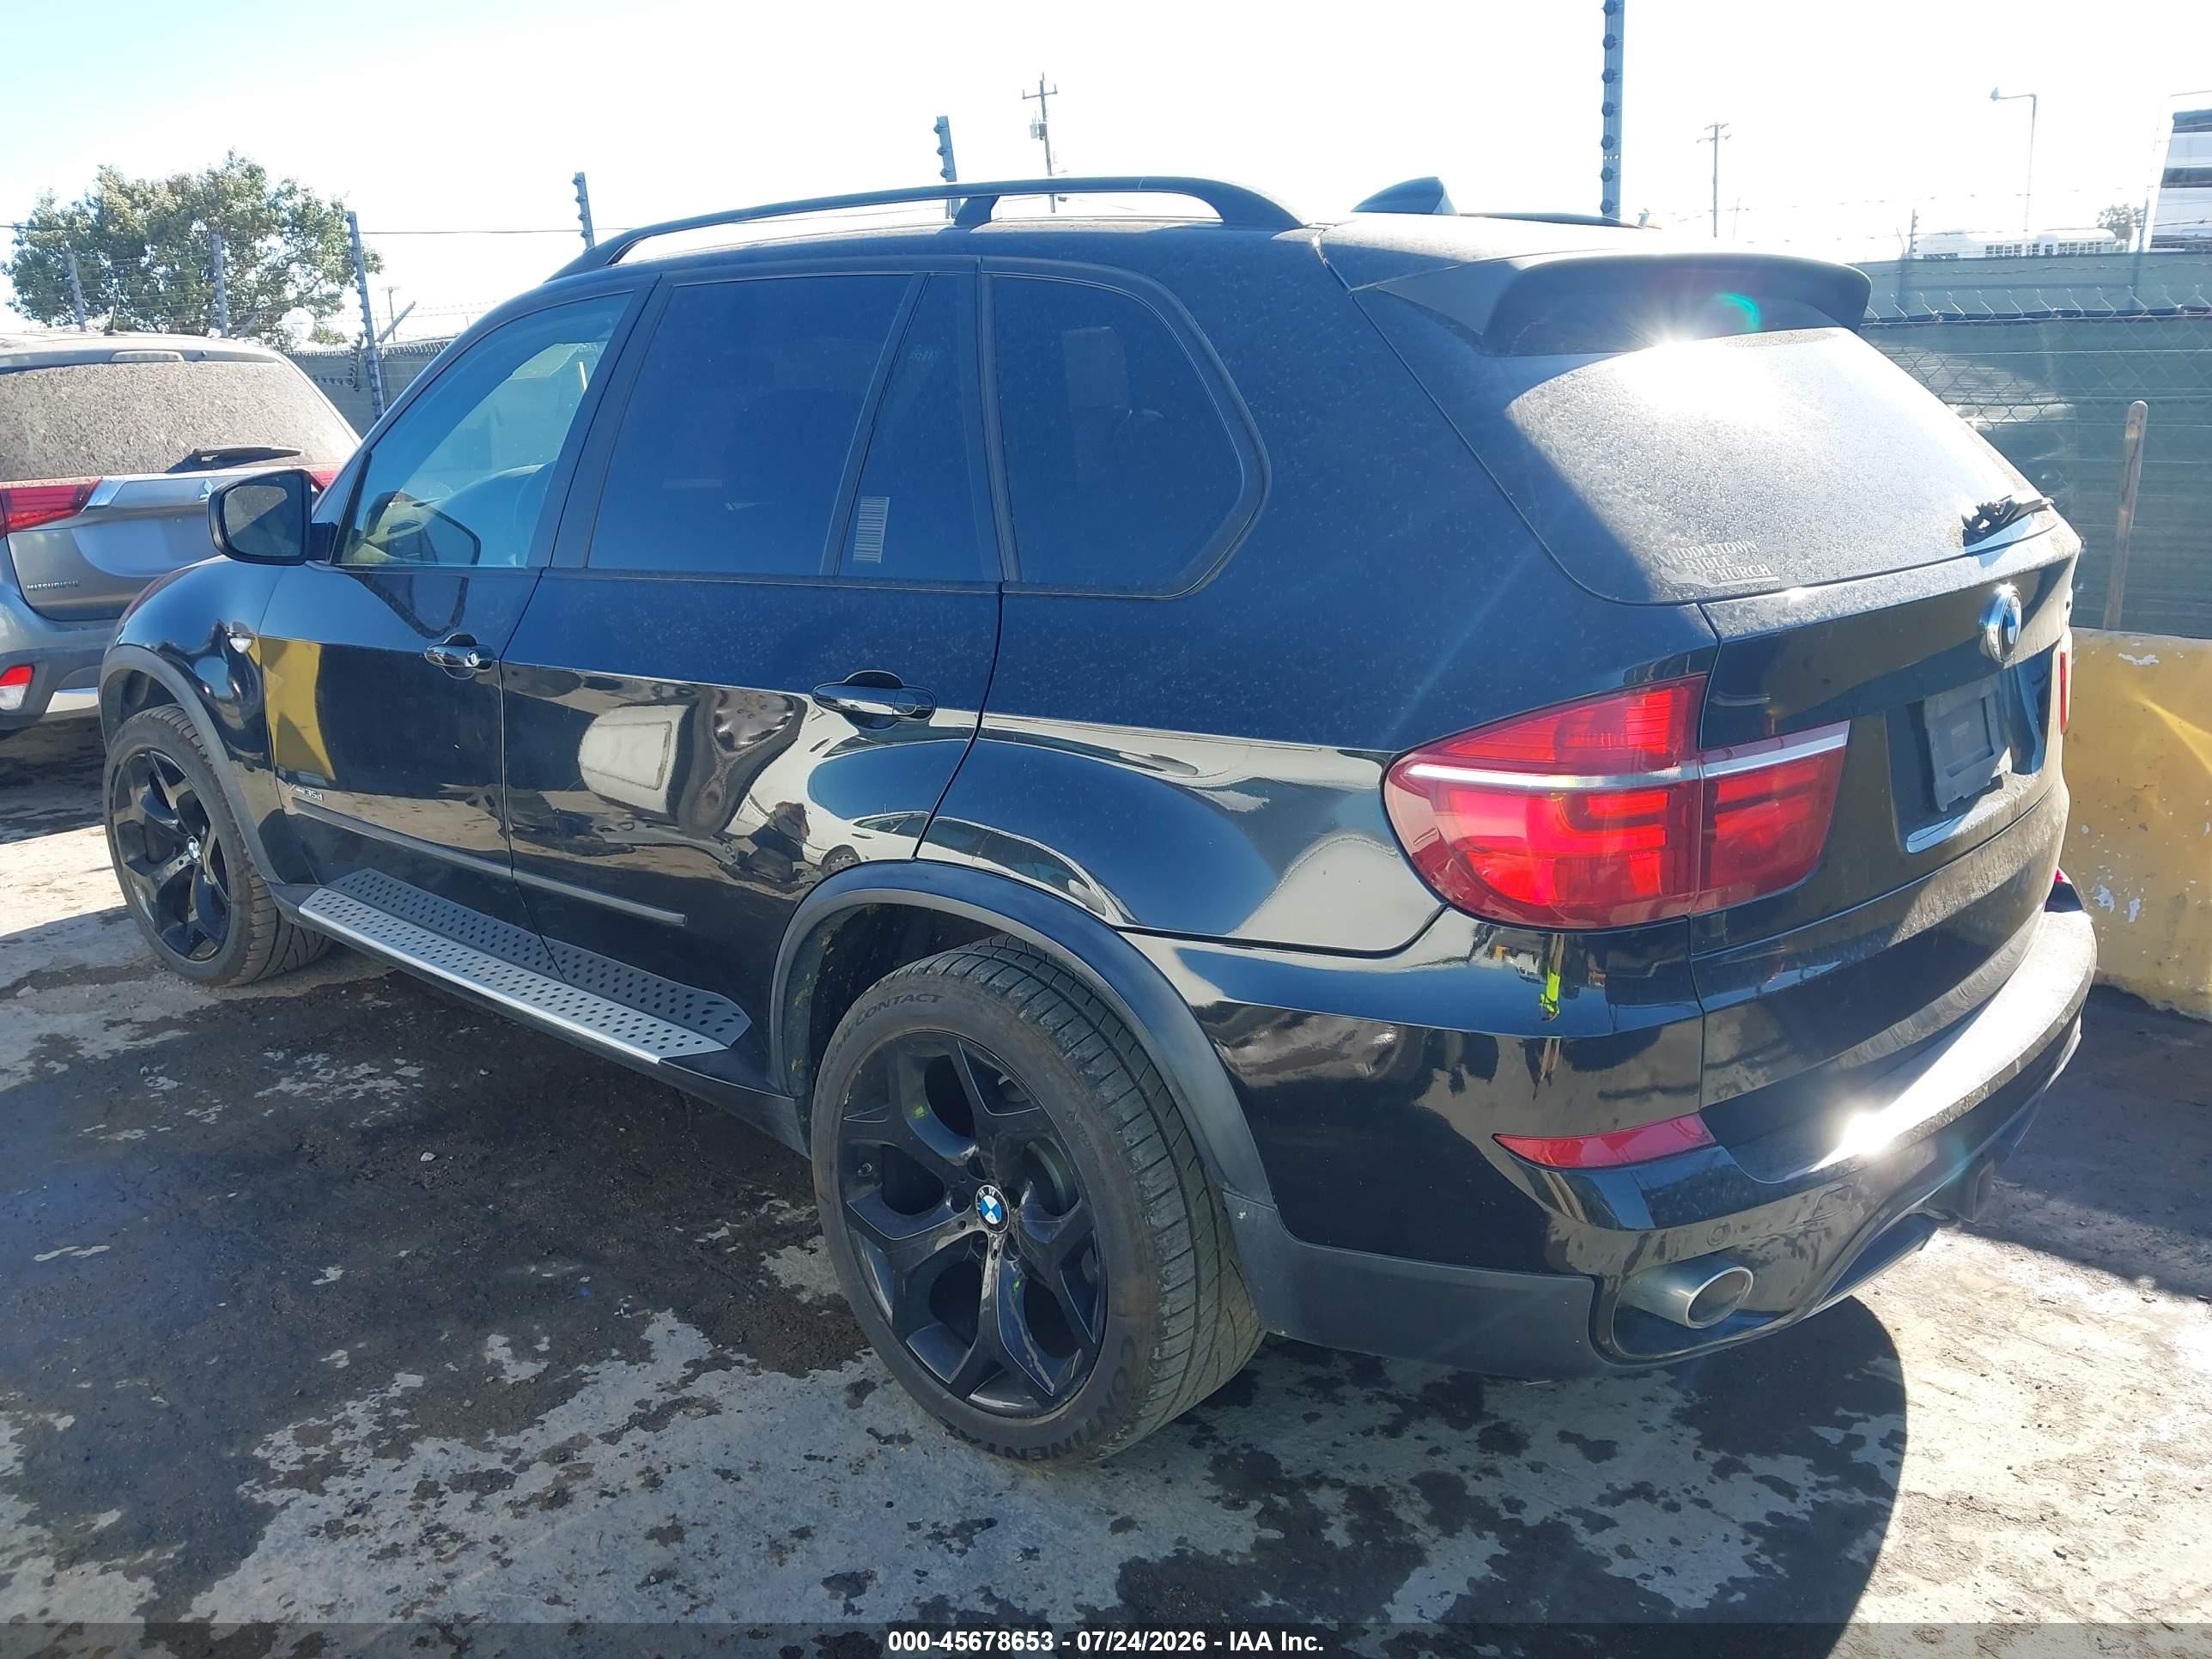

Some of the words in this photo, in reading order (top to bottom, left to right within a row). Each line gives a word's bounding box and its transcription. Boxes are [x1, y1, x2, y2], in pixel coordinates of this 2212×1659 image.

[1651, 540, 1760, 568] MIDDLETOWN
[1684, 554, 1735, 570] BIBLE
[1703, 562, 1771, 585] CHURCH
